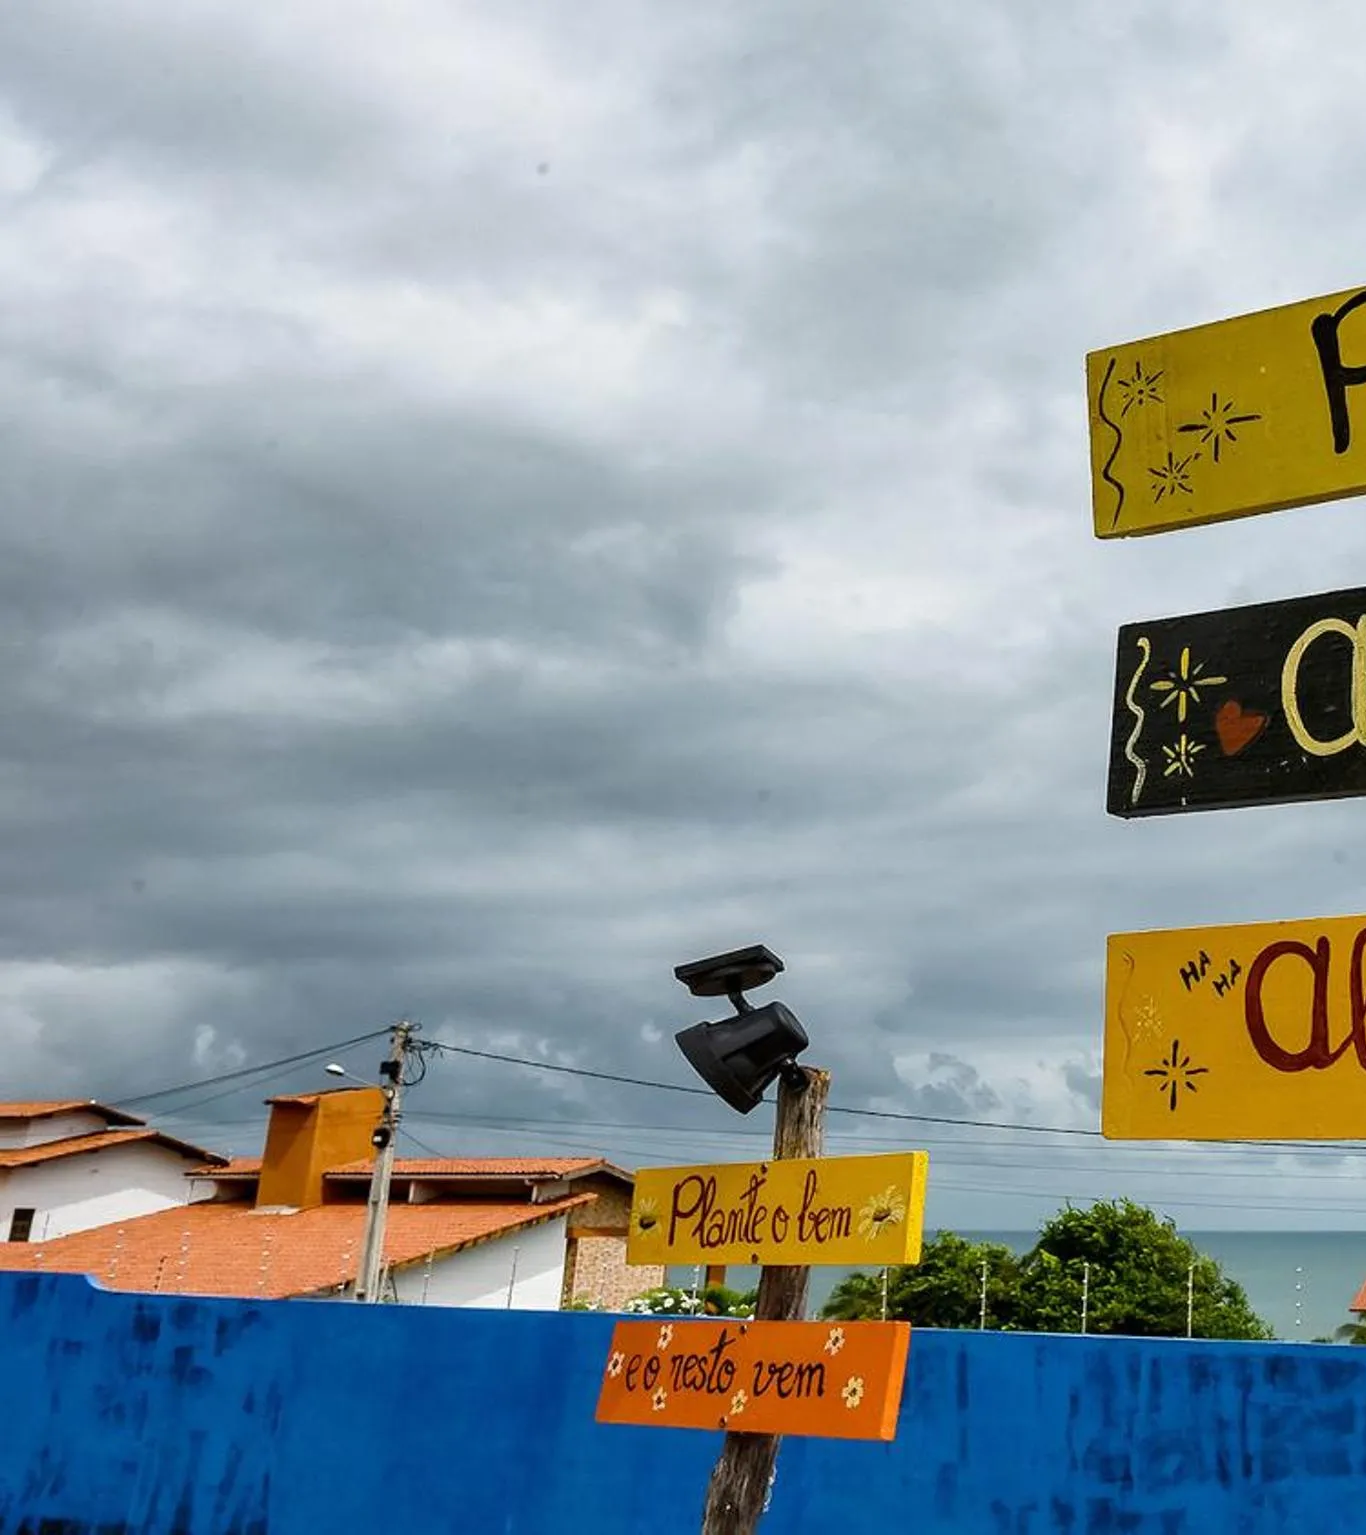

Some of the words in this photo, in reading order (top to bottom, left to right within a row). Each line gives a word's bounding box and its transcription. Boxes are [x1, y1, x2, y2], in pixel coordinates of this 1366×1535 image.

[1179, 951, 1211, 992] HA
[1212, 958, 1242, 997] HA
[668, 1174, 767, 1248] Plante
[771, 1206, 790, 1241] o
[797, 1169, 851, 1243] bem
[625, 1354, 642, 1391] e
[643, 1356, 661, 1390] o
[671, 1329, 736, 1394] resto
[752, 1360, 825, 1398] vem
